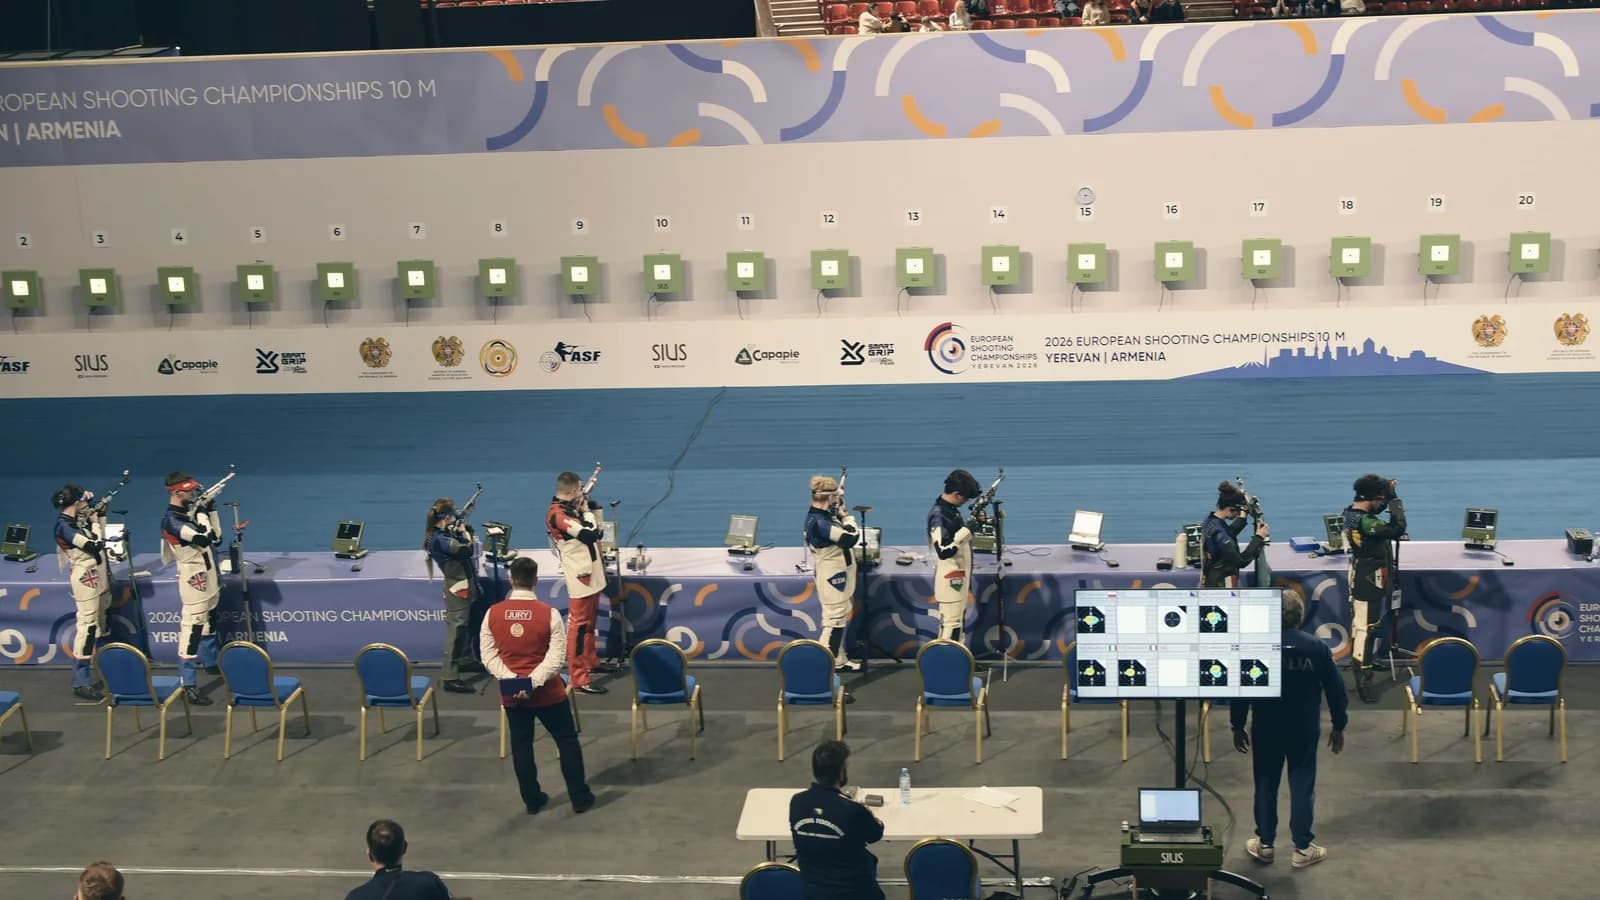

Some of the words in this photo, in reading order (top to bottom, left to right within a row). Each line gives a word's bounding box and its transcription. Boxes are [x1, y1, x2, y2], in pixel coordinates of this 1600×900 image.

[83, 87, 198, 109] SHOOTING
[203, 80, 384, 105] CHAMPIONSHIPS
[388, 80, 412, 99] 10
[418, 79, 437, 97] M
[26, 119, 122, 141] ARMENIA
[1430, 198, 1442, 207] 19
[1519, 195, 1533, 205] 20
[1165, 206, 1177, 214] 16
[1253, 203, 1265, 211] 17
[1341, 201, 1354, 210] 18
[908, 212, 919, 220] 13
[993, 210, 1005, 218] 14
[1080, 207, 1091, 216] 15
[656, 219, 669, 228] 10
[741, 217, 750, 225] 11
[823, 215, 835, 223] 12
[495, 224, 502, 232] 8
[576, 221, 584, 229] 9
[255, 230, 262, 239] 5
[333, 228, 341, 236] 6
[413, 226, 420, 234] 7
[96, 235, 103, 244] 3
[175, 232, 183, 241] 4
[21, 237, 28, 246] 2
[1045, 337, 1073, 347] 2026
[1076, 335, 1141, 346] EUROPEAN
[1144, 334, 1210, 346] SHOOTING
[1213, 331, 1315, 344] CHAMPIONSHIPS
[1318, 331, 1330, 342] 10
[1335, 331, 1345, 341] M
[570, 351, 601, 361] ASF
[652, 343, 687, 361] SIUS
[753, 349, 800, 361] Capapie
[971, 353, 1038, 362] CHAMPIONSHIPS
[1045, 352, 1101, 363] YEREVAN
[1111, 351, 1167, 362] ARMENIA
[74, 354, 109, 372] SIUS
[174, 359, 218, 371] Capapie
[148, 610, 181, 623] 2026
[263, 610, 337, 622] SHOOTING
[507, 611, 529, 619] JURY
[1160, 852, 1184, 864] SIUS
